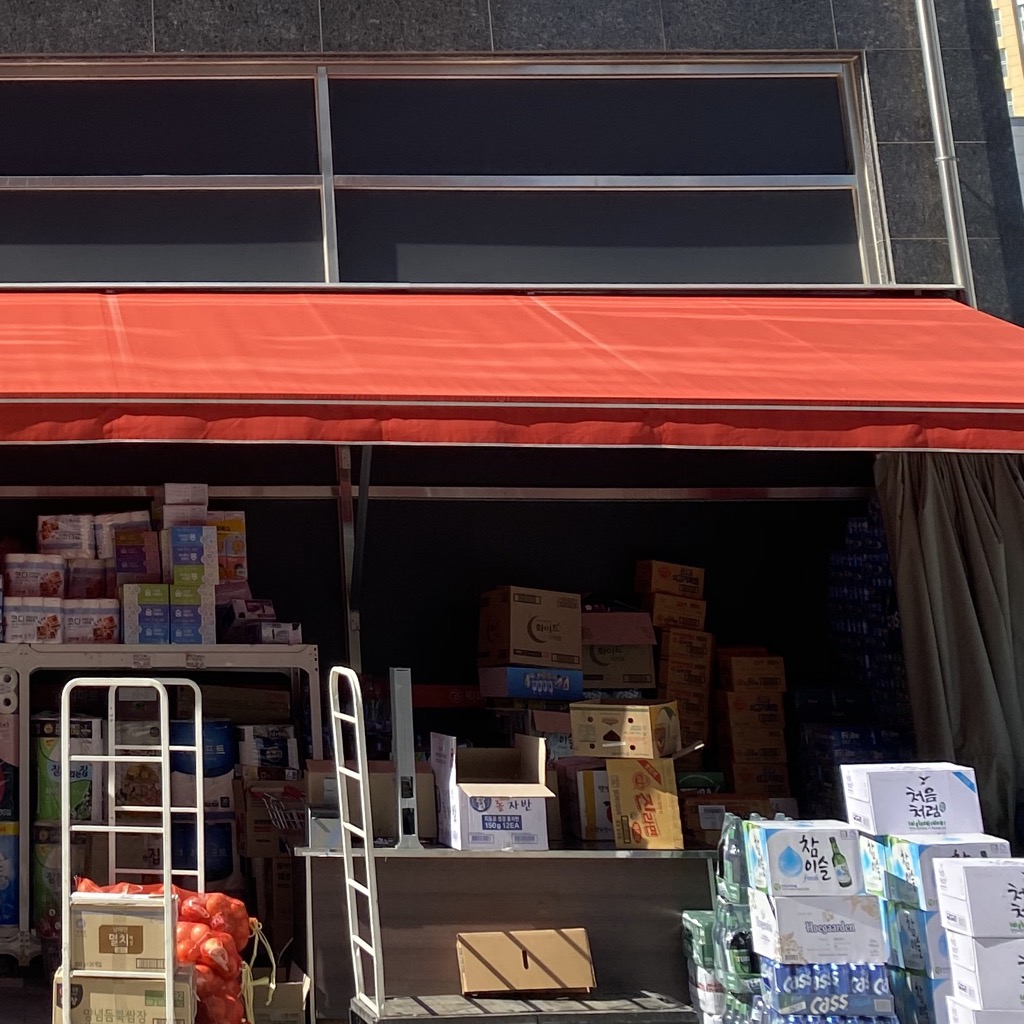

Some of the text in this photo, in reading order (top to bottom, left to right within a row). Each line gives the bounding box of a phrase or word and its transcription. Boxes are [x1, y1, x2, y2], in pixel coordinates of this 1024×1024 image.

[906, 786, 937, 803] 처음
[909, 804, 942, 819] 처럼
[799, 835, 820, 859] 참
[804, 856, 832, 882] 이슬
[804, 920, 856, 935] Hoegaarden
[108, 933, 129, 948] 멸치
